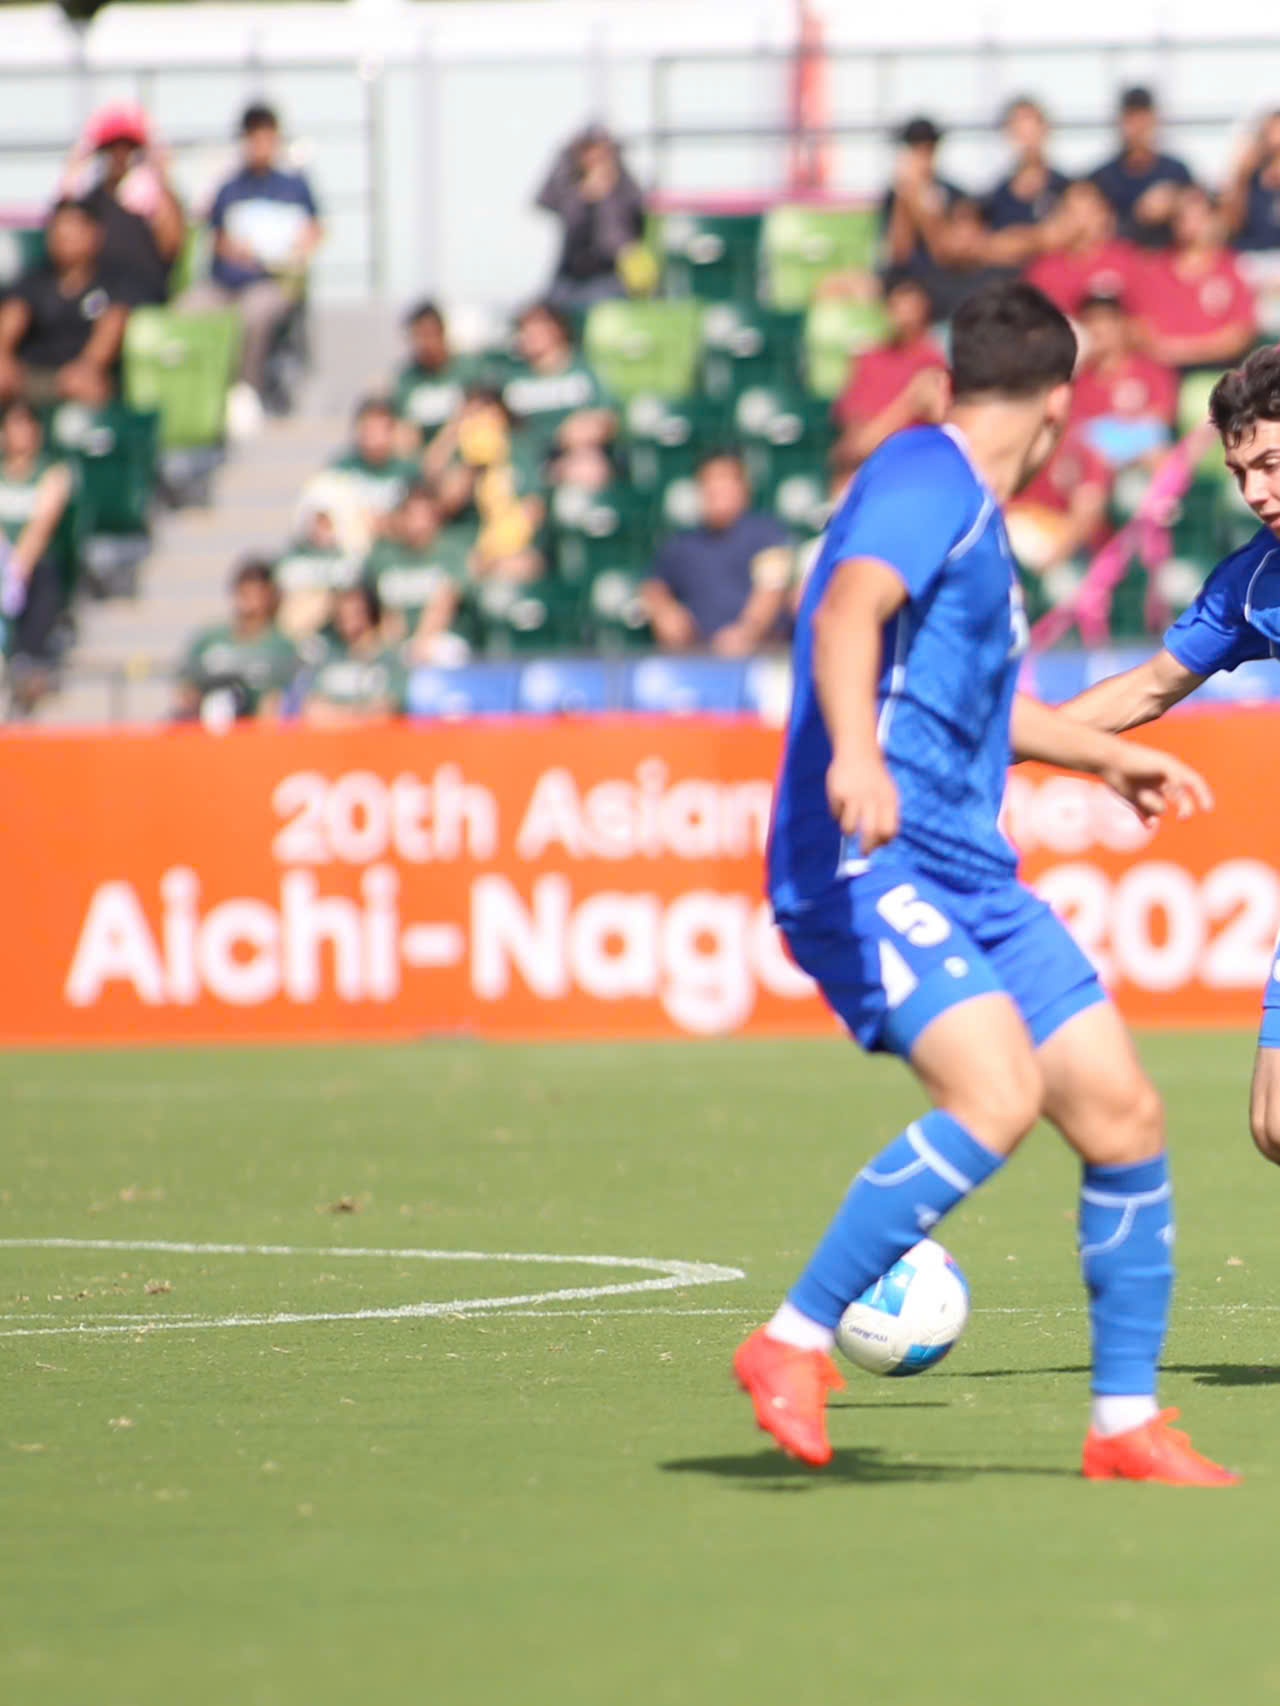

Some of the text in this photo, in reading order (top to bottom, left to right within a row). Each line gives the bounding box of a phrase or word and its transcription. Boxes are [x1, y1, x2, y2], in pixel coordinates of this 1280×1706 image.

[272, 757, 774, 863] 20th Asian
[65, 864, 818, 1034] Aichi-Nag
[876, 883, 953, 948] 5
